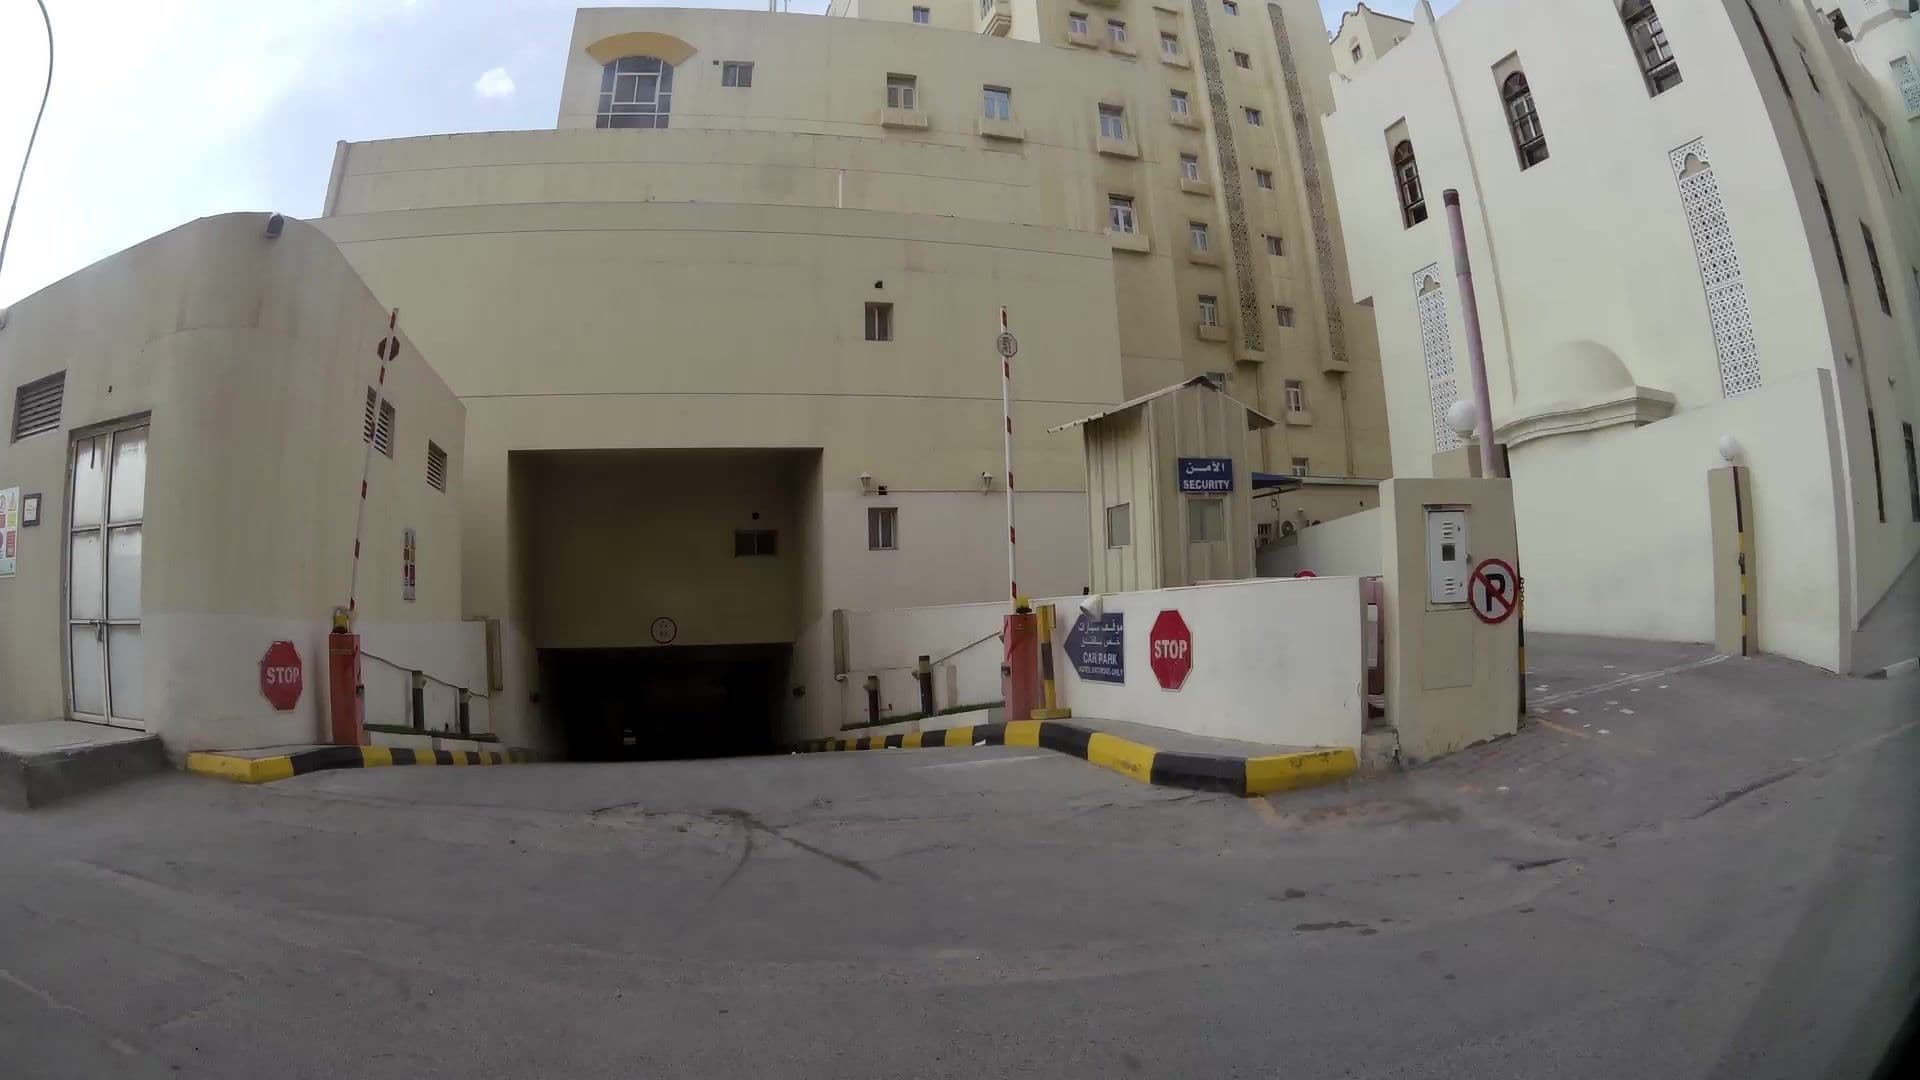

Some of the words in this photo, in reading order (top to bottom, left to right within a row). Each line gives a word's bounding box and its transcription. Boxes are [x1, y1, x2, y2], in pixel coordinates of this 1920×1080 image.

[1183, 479, 1230, 490] SECURITY
[1154, 639, 1188, 660] STOP
[1083, 651, 1098, 664] CAR
[1098, 652, 1118, 665] PARK
[266, 666, 300, 685] STOP
